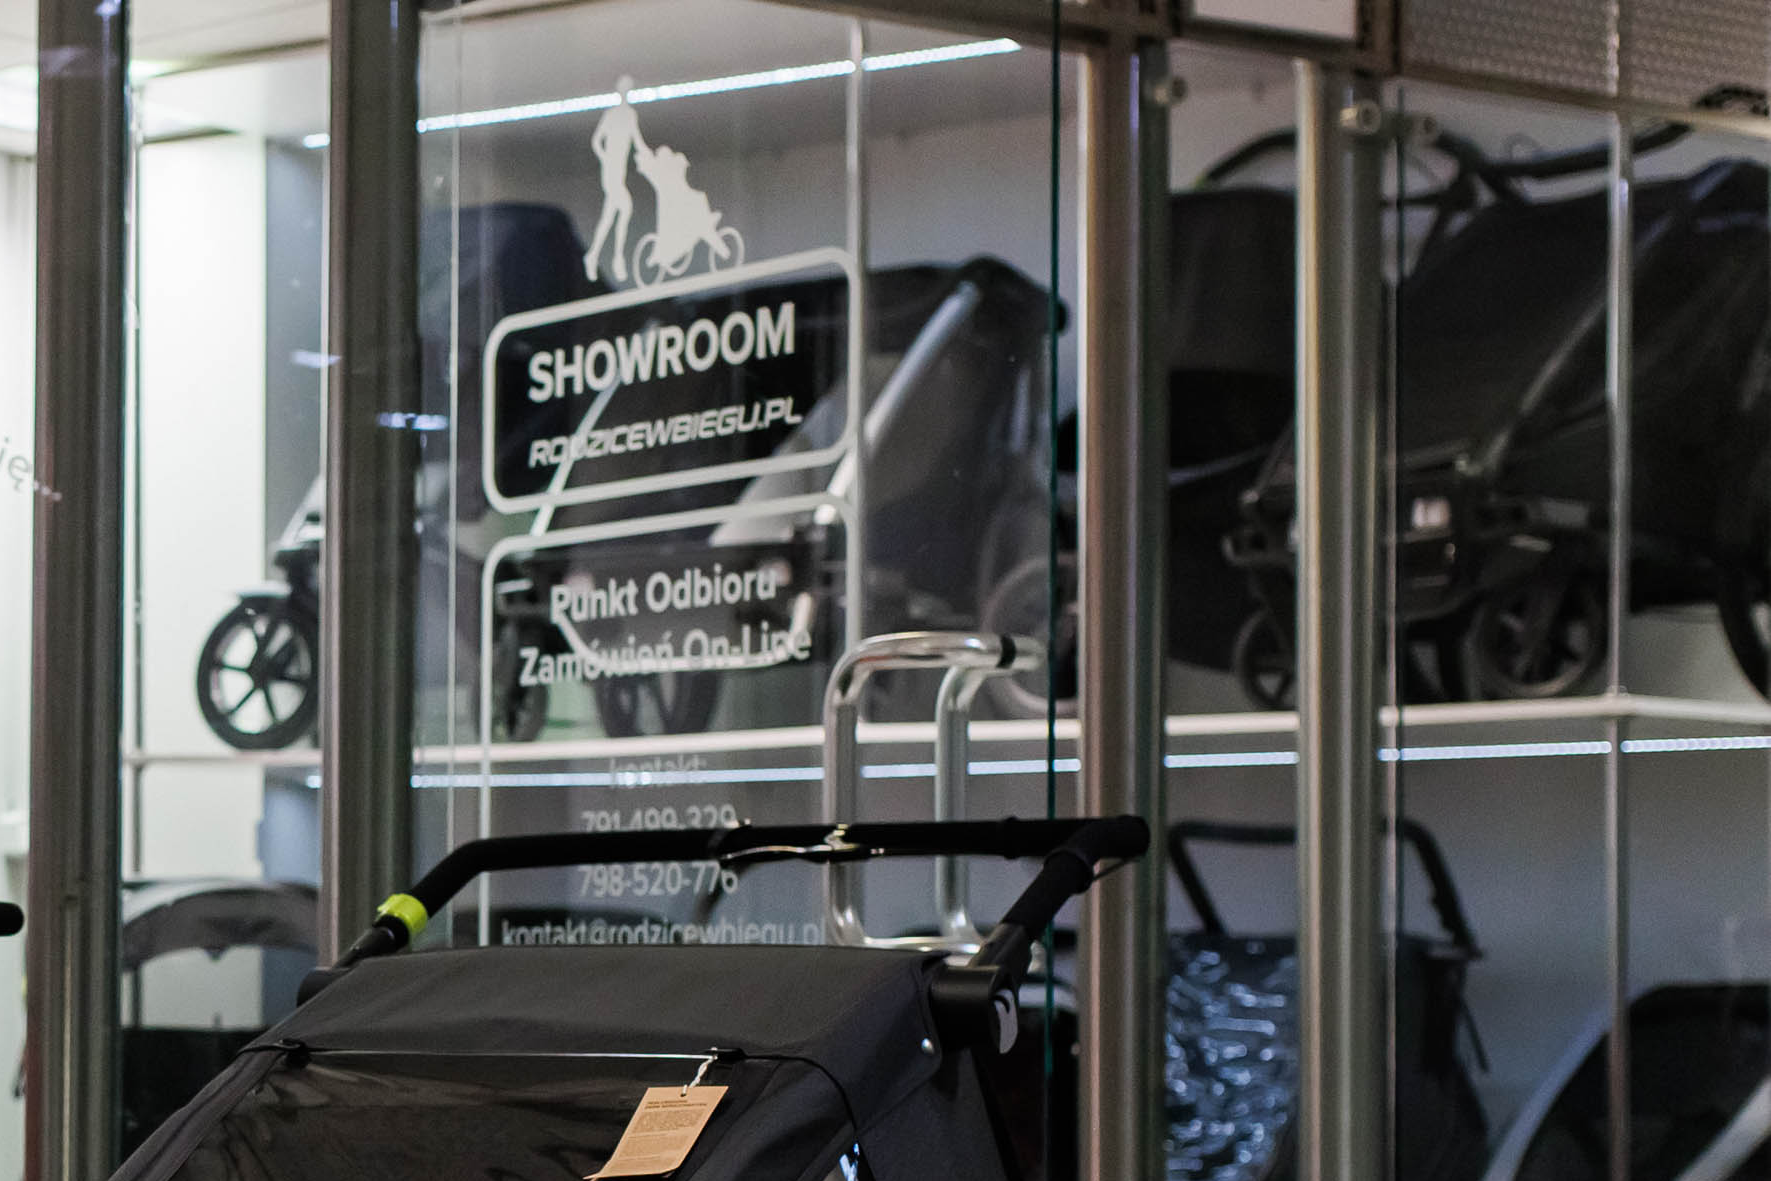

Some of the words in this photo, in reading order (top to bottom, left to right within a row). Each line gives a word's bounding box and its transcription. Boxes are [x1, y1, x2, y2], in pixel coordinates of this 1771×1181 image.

[528, 302, 795, 403] SHOWROOM
[529, 397, 803, 469] RODZICEWBIEGU.PL
[550, 577, 639, 624] Punkt
[645, 563, 777, 613] Odbioru
[519, 631, 675, 687] Zamówień
[578, 861, 740, 898] 798-520-776
[502, 916, 827, 945] kontakt@rodzicewbiegupl
